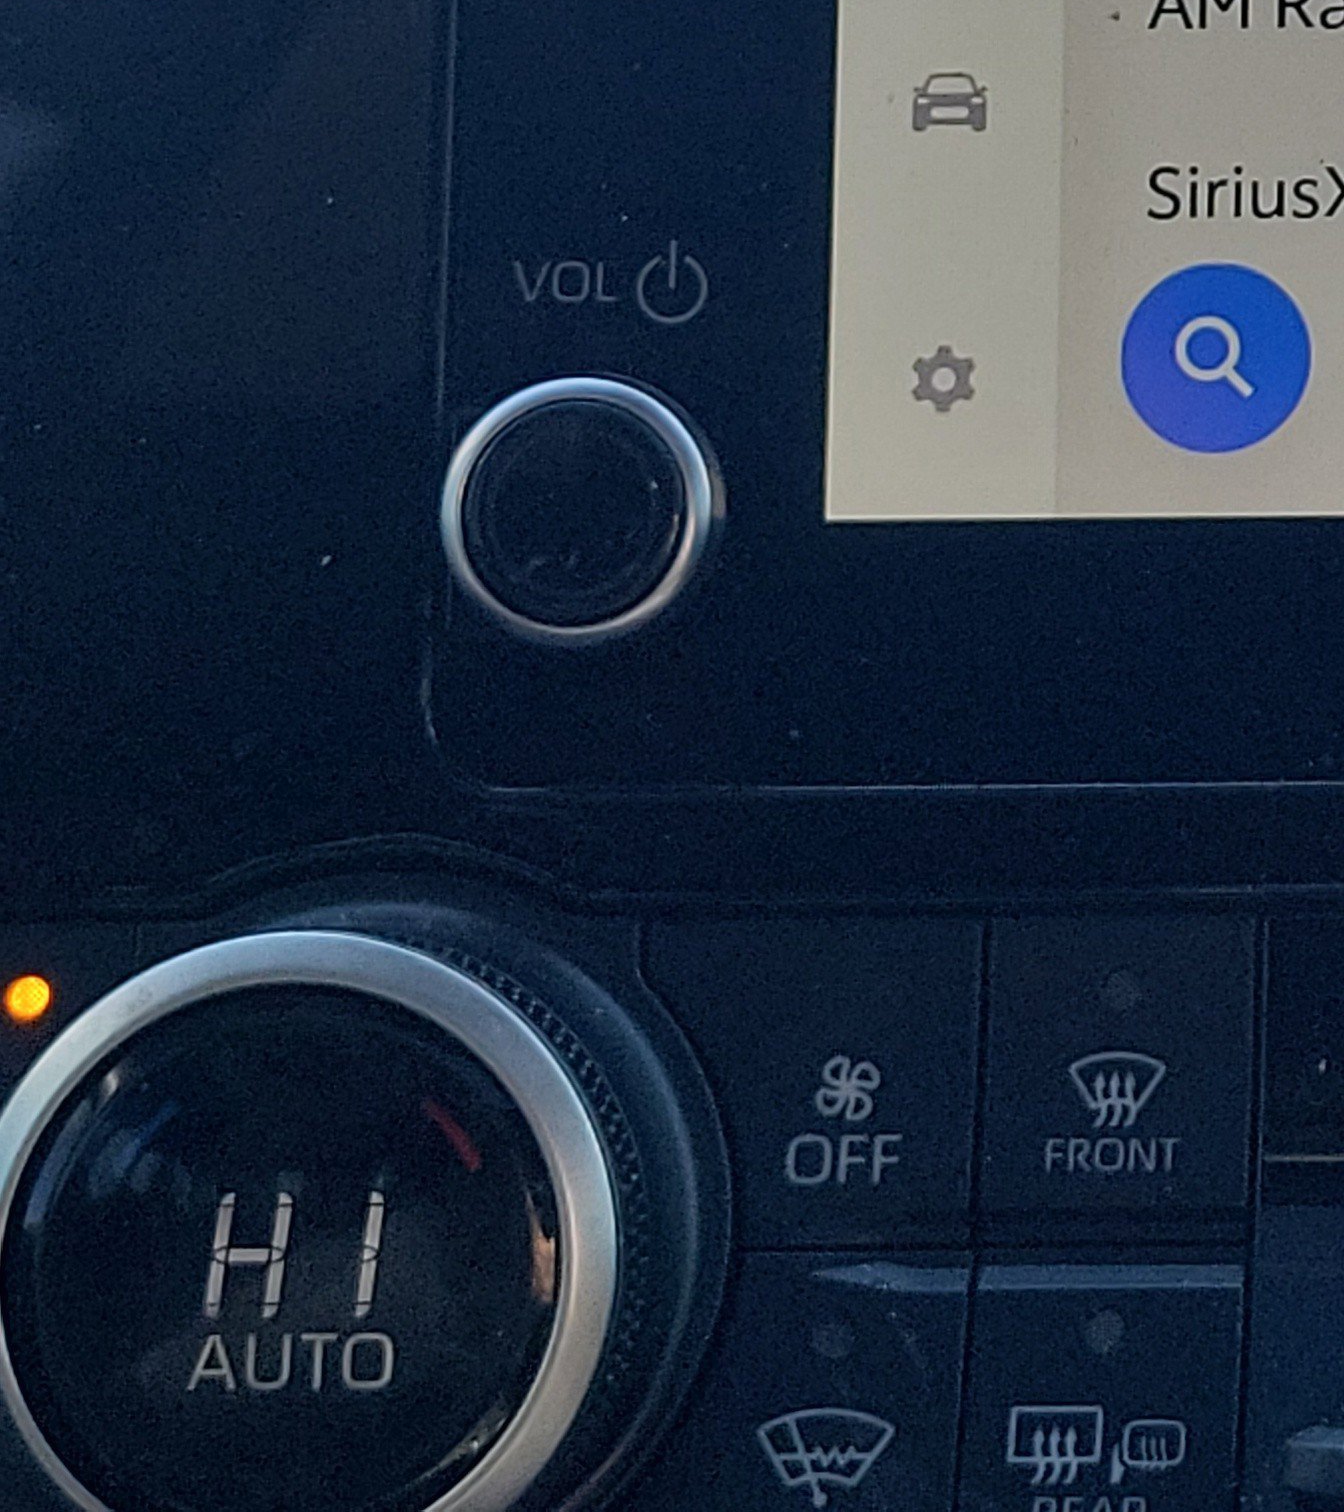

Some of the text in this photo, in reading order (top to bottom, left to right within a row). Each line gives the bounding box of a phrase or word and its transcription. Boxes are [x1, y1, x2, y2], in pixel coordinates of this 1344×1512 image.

[513, 260, 617, 303] VOL
[784, 1133, 903, 1185] OFF
[1044, 1137, 1181, 1172] FRONT
[186, 1332, 395, 1390] AUTO
